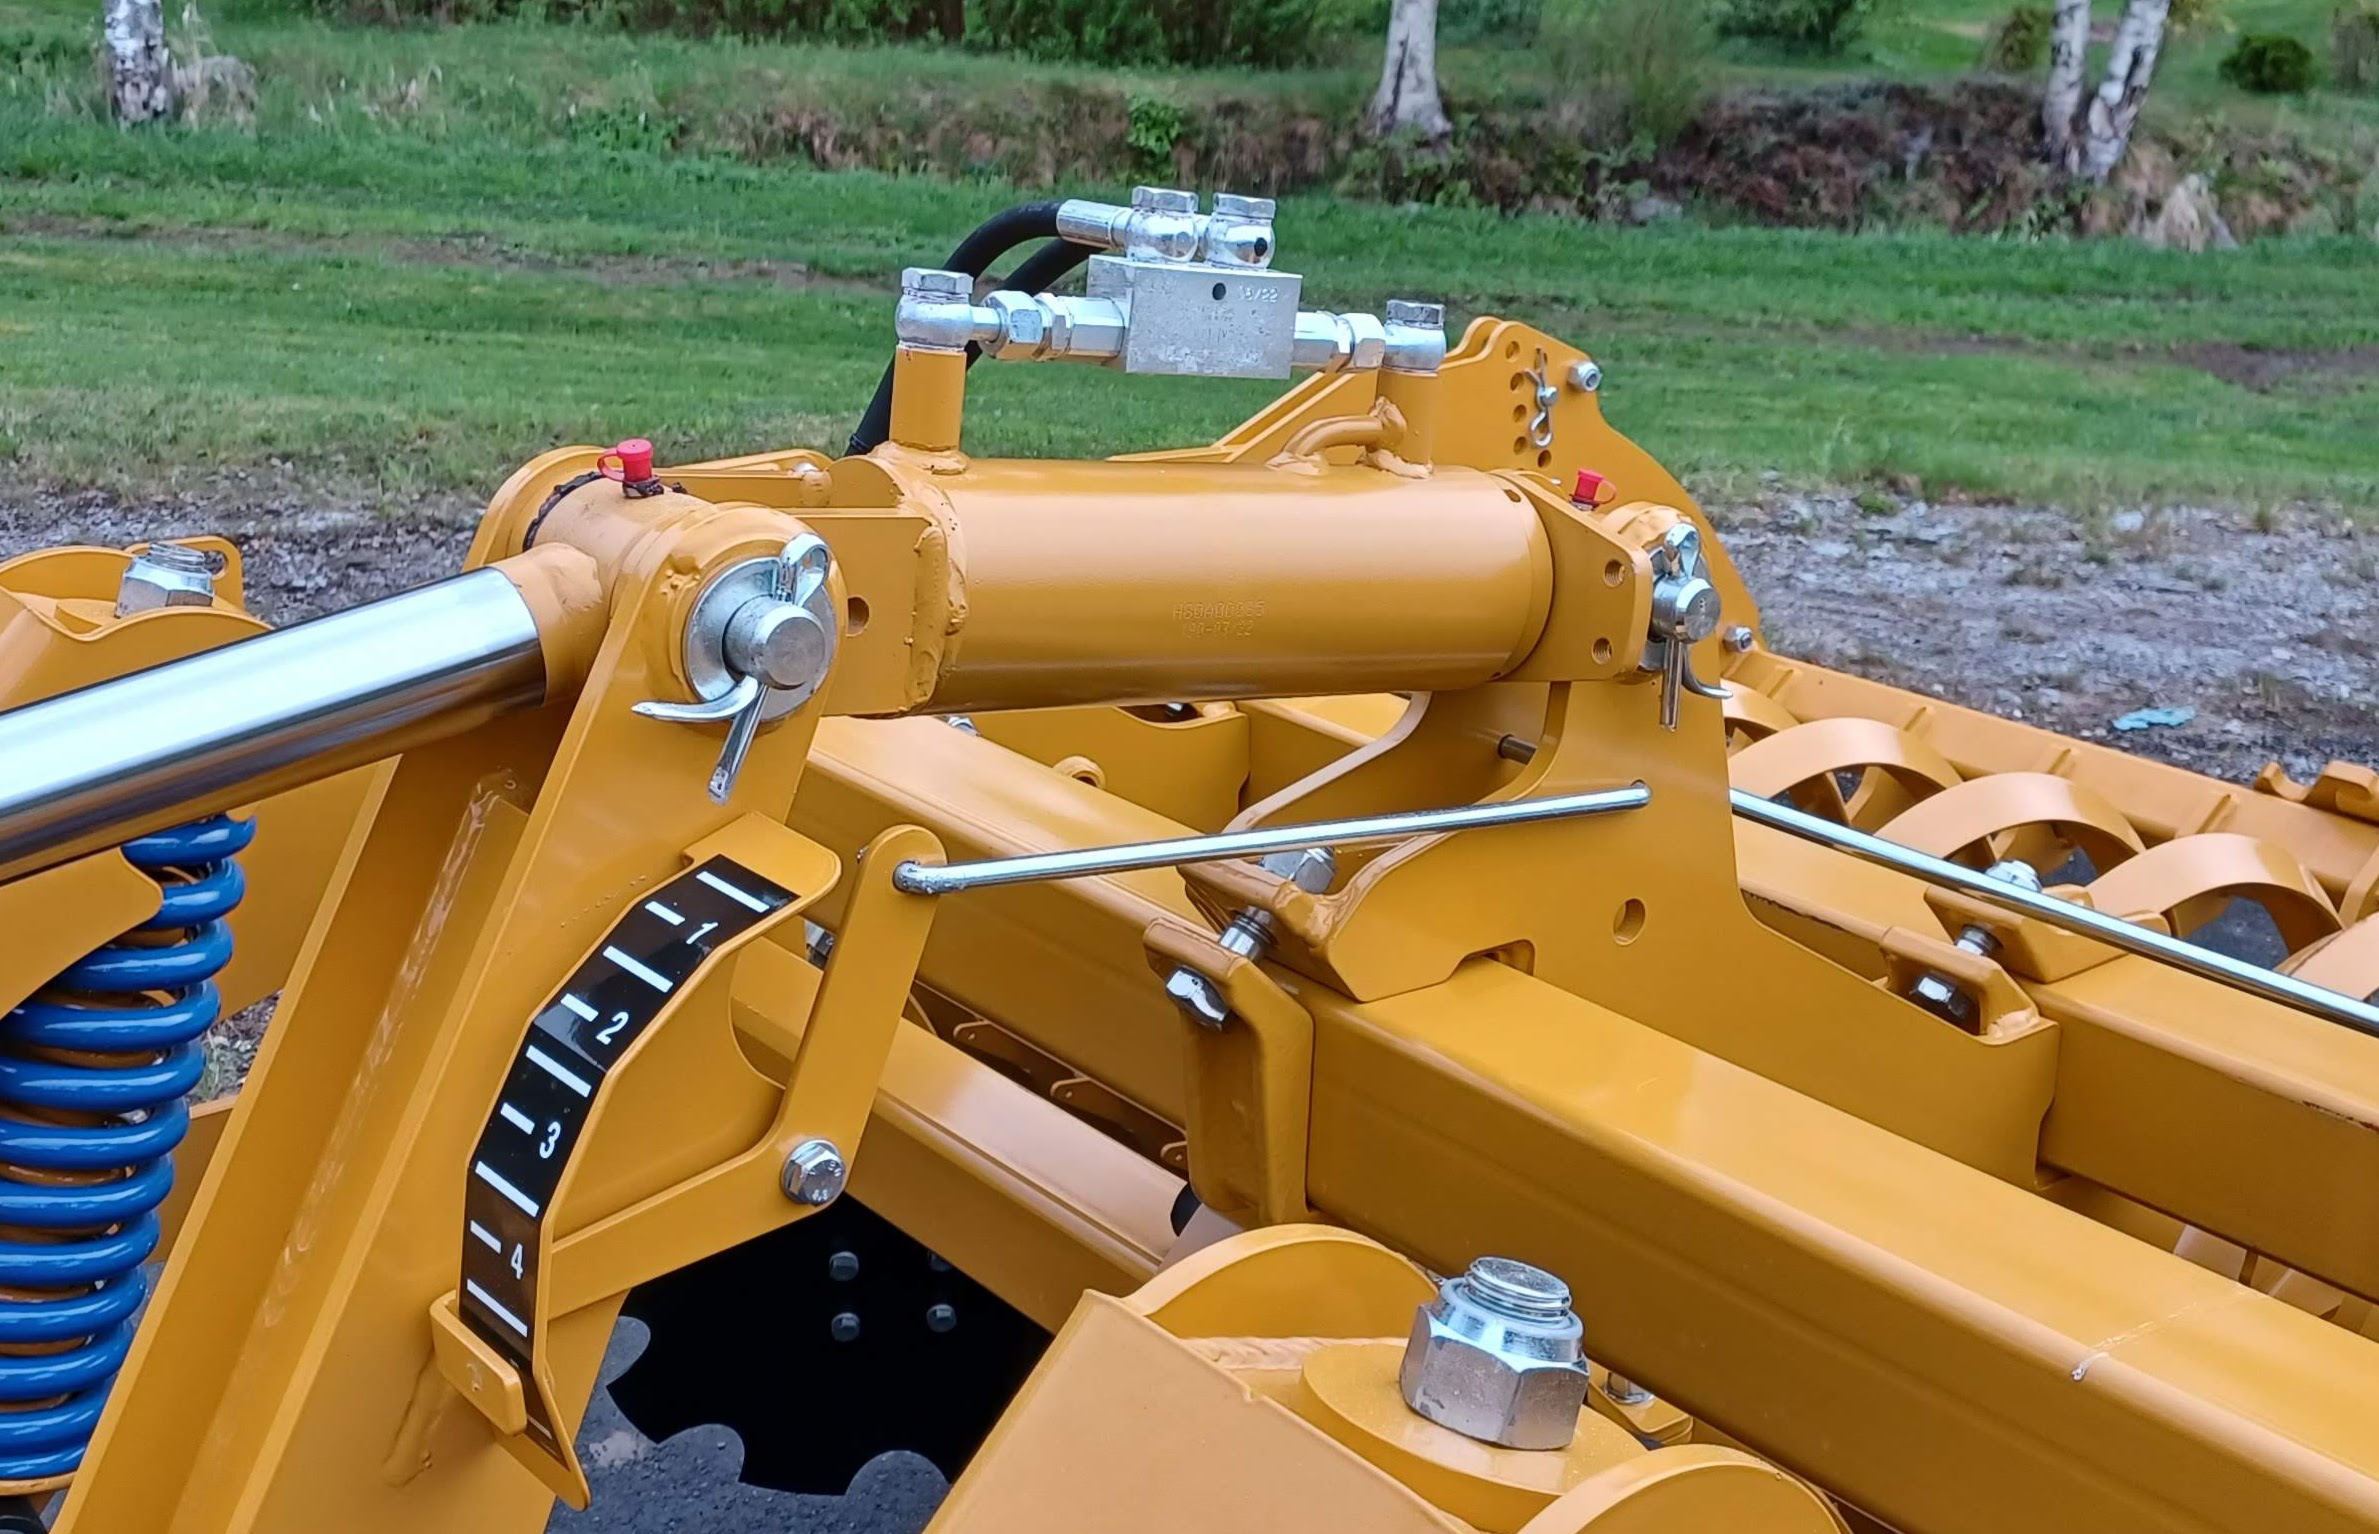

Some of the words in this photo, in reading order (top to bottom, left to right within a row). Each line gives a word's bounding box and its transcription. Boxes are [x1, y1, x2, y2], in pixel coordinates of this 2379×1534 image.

[686, 921, 719, 945] 1
[596, 1011, 629, 1046] 2
[540, 1121, 561, 1159] 3
[510, 1243, 524, 1280] 4
